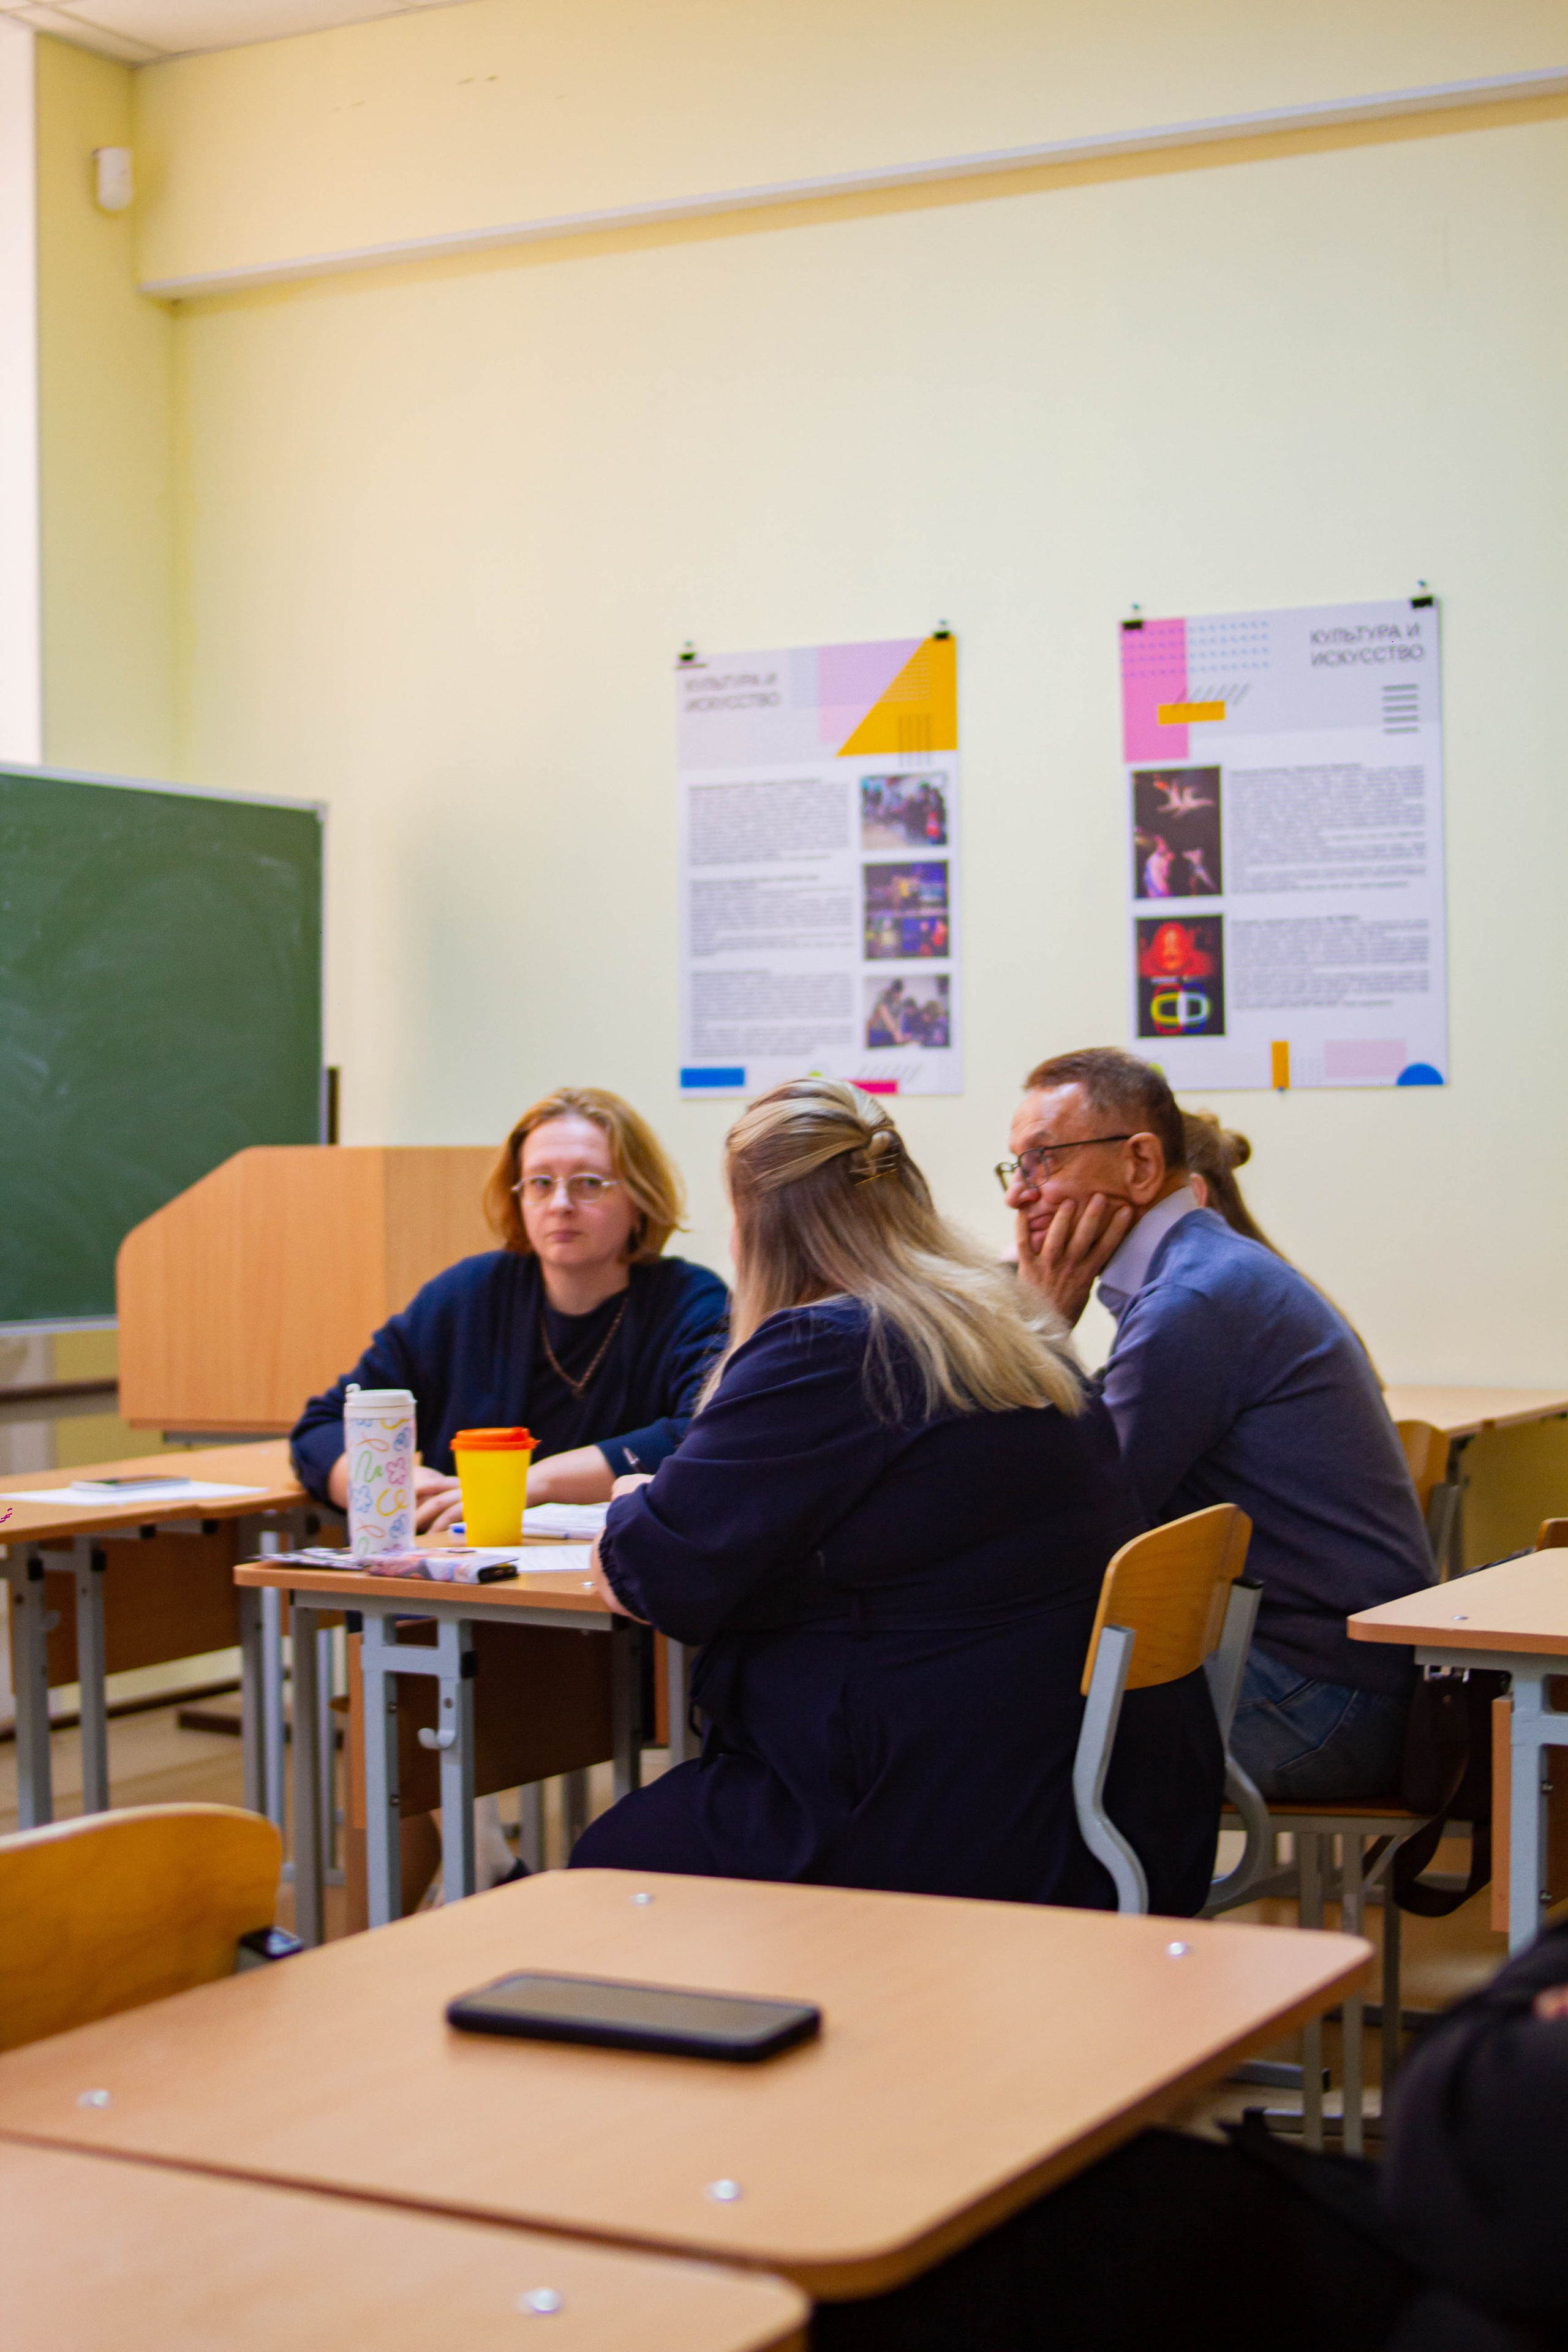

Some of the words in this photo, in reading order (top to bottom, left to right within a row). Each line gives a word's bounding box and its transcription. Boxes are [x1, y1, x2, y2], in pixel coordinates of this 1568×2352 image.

[1310, 624, 1401, 644] КУЛЬТУРА
[1406, 621, 1421, 639] И
[1311, 643, 1425, 668] ИСКУССТВО
